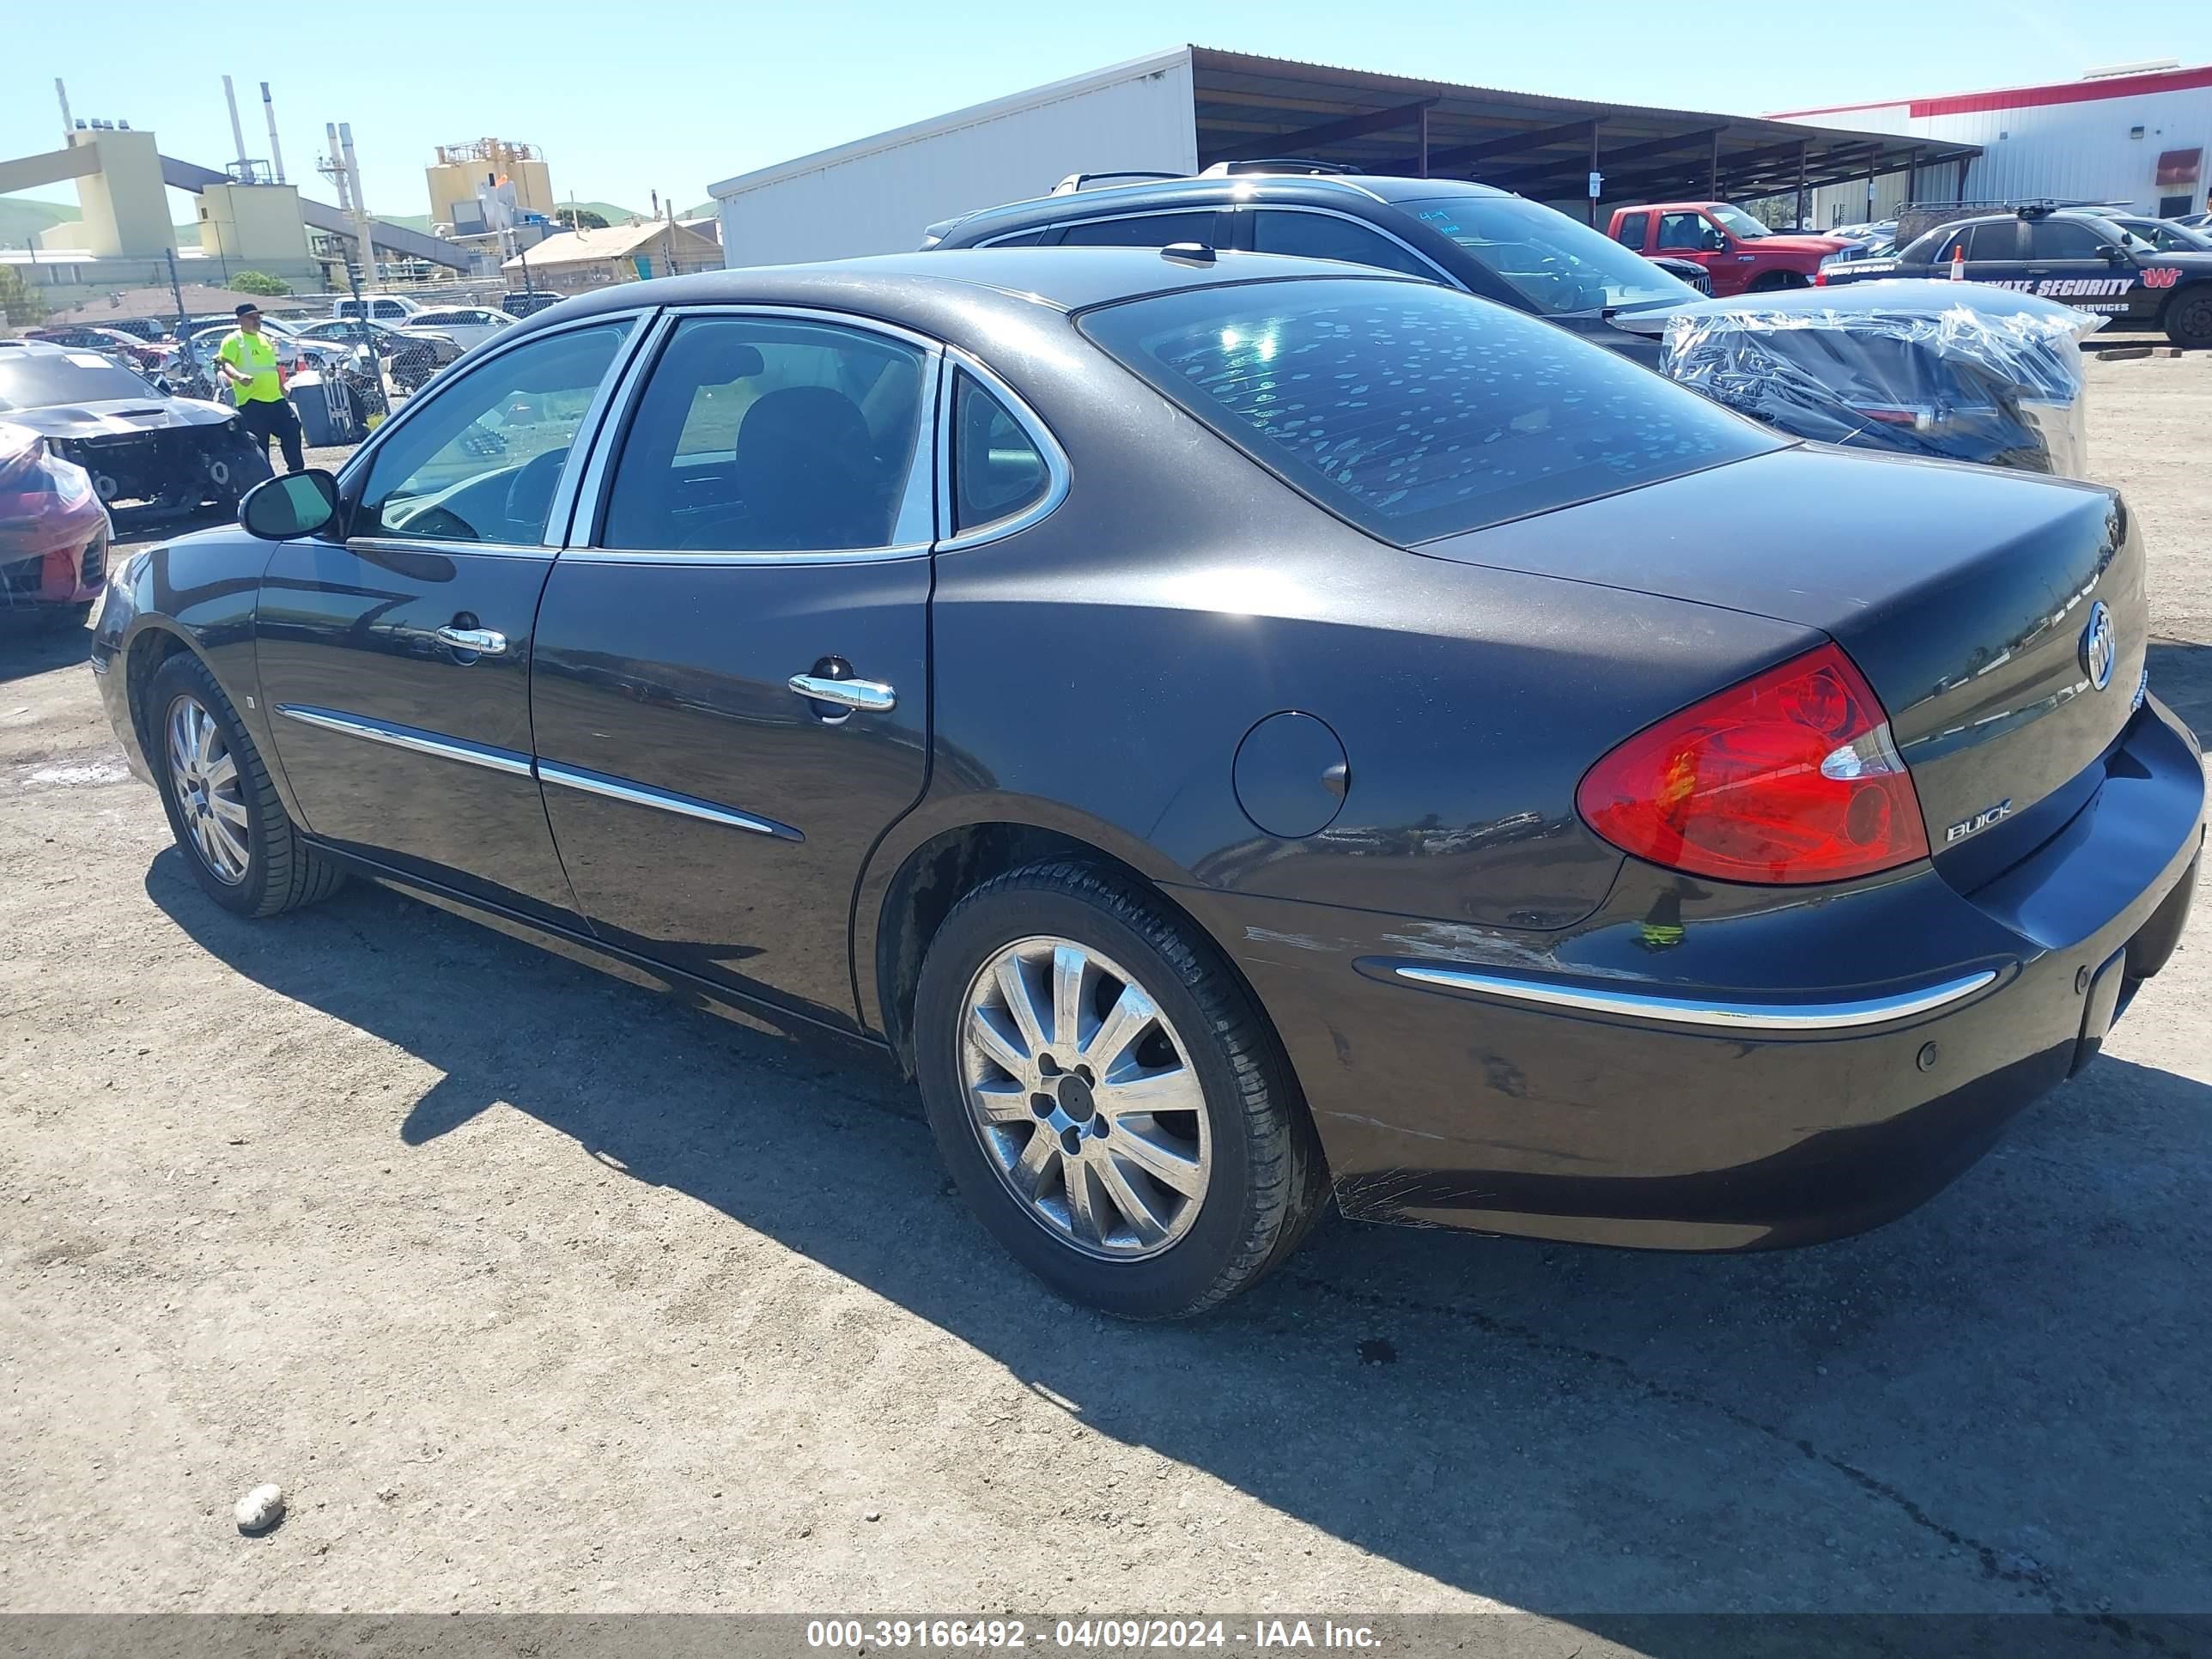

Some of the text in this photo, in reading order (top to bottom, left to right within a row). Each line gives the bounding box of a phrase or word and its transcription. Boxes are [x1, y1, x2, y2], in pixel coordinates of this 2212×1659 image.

[2036, 278, 2135, 296] SECURITY
[2072, 303, 2130, 313] SERVICES
[1945, 798, 2013, 842] BUICK
